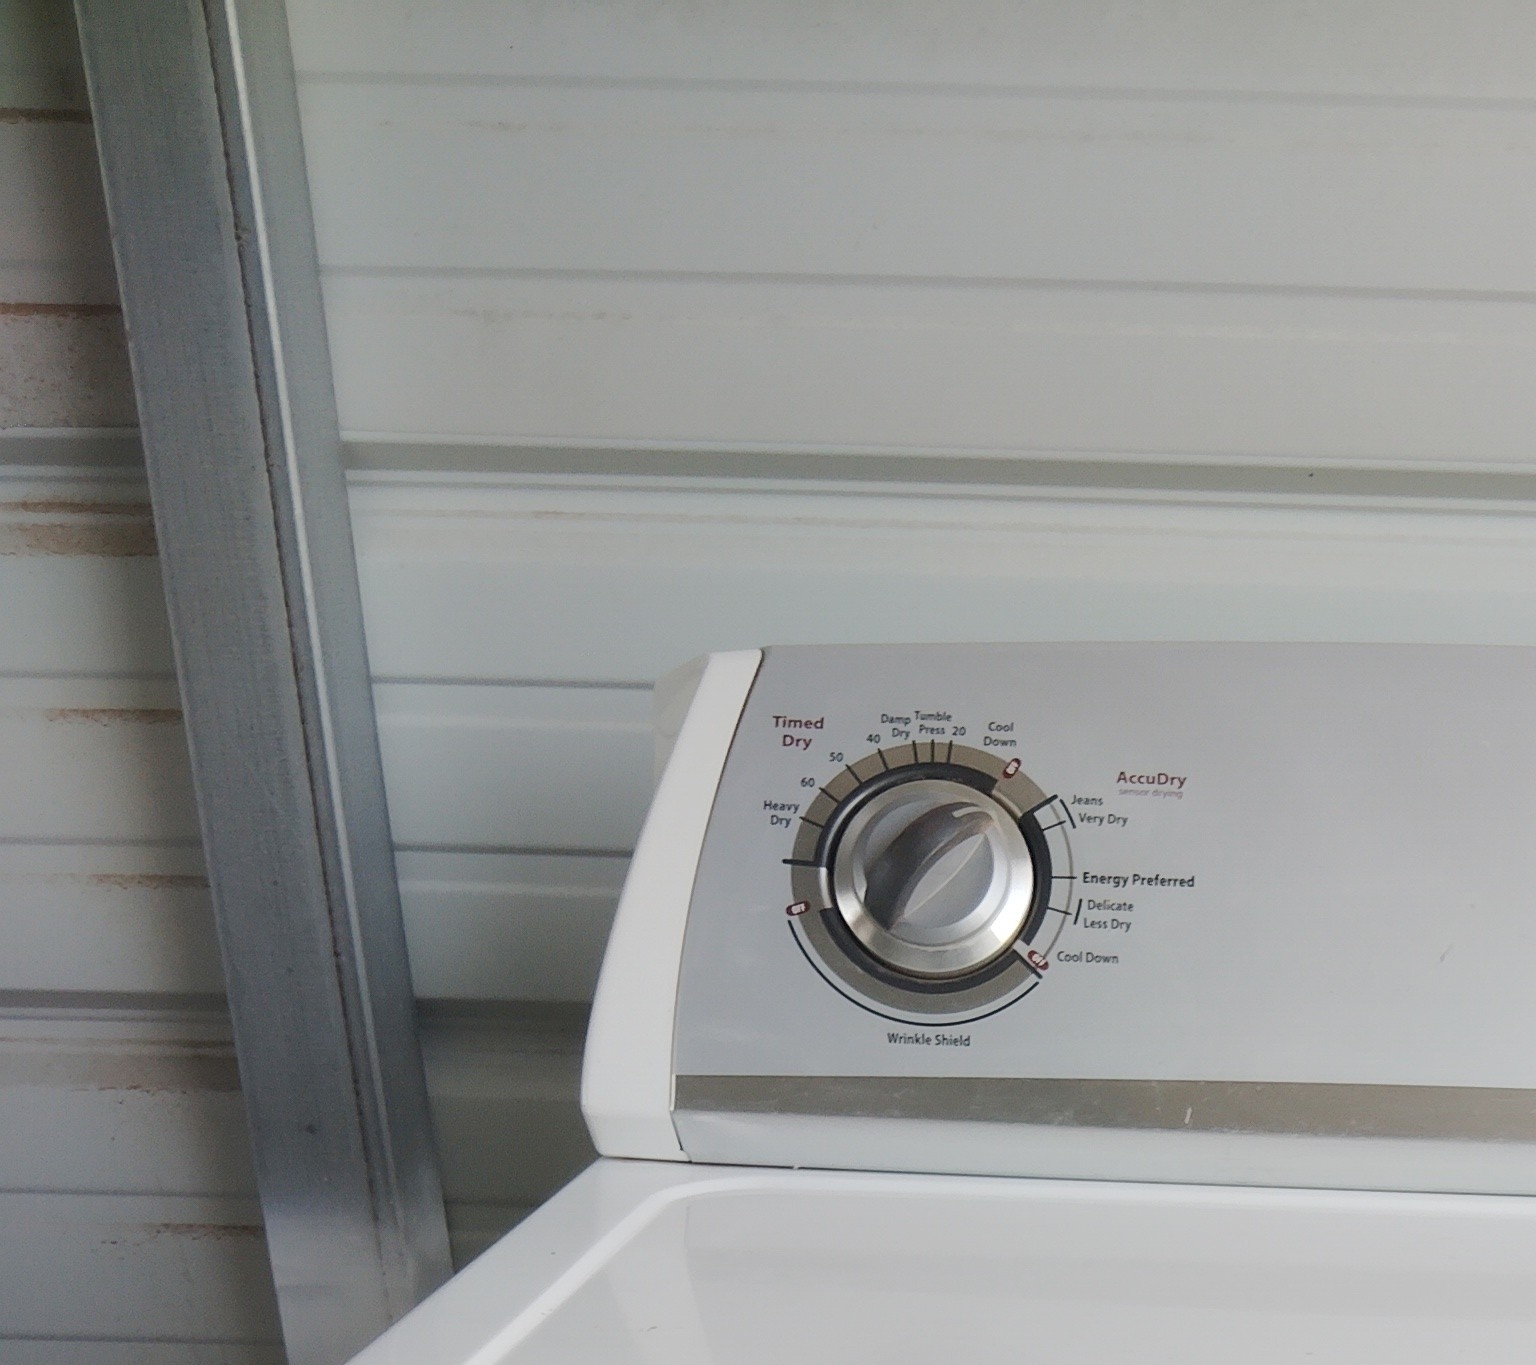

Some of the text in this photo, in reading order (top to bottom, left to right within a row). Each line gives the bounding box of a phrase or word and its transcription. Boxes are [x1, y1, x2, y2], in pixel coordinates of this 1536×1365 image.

[772, 715, 825, 731] Timed
[880, 714, 911, 727] Damp
[914, 711, 952, 723] Tumble
[918, 725, 946, 737] Press
[951, 727, 967, 738] 20
[988, 722, 1014, 733] Cool
[866, 734, 881, 745] 40
[891, 728, 911, 740] Dry
[781, 735, 813, 751] Dry
[983, 737, 1017, 748] Down
[829, 752, 844, 763] 50
[800, 777, 816, 789] 60
[1116, 771, 1187, 789] AccuDry
[763, 800, 800, 814] Heavy
[1071, 795, 1104, 807] Jeans
[770, 814, 792, 828] Dry
[1079, 814, 1128, 827] Very Dry
[1082, 872, 1195, 888] Energy Preferred
[1087, 900, 1134, 912] Delicate
[1084, 918, 1132, 932] Less Dry
[1057, 952, 1120, 964] Cool Down
[887, 1033, 971, 1047] Wrinkle Shield
